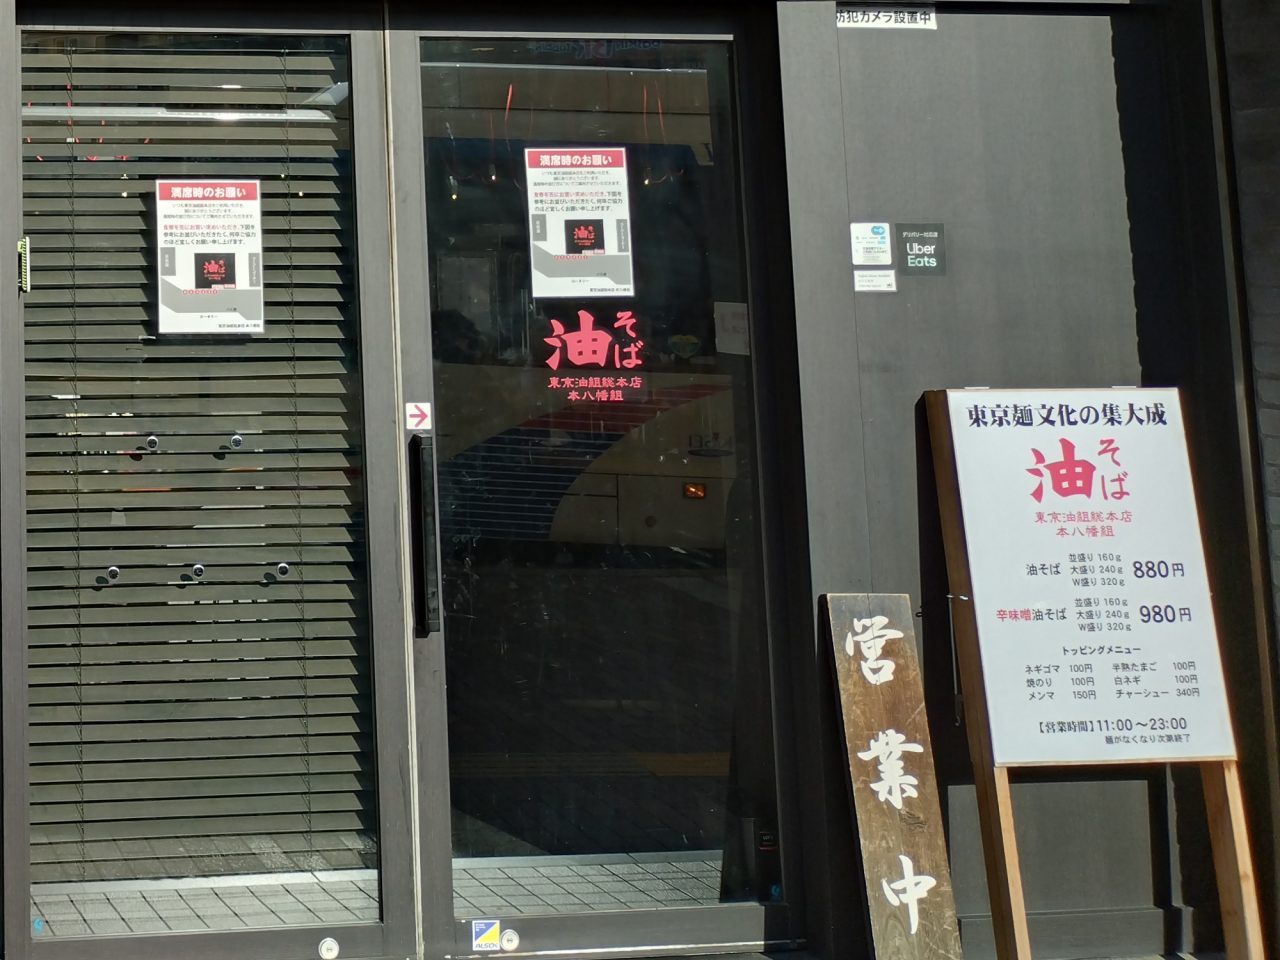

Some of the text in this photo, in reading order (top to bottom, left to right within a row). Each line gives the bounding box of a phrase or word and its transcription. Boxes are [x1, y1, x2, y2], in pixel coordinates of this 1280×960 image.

[540, 155, 612, 166] 満席時のお願い
[170, 187, 246, 198] 満席時のお願い
[906, 243, 935, 254] Uber
[907, 256, 937, 267] Eats
[543, 309, 644, 370] 油 そば
[547, 376, 642, 389] 東京油組総本店
[567, 390, 624, 402] 本八幡組
[966, 403, 1168, 428] 東京麺文化の集大成
[1025, 437, 1130, 504] 油 そば
[1034, 510, 1133, 523] 東京油組総本店
[1055, 525, 1116, 537] 本八幡組
[1025, 563, 1061, 576] 油そば
[1062, 646, 1141, 655] トッピングメニュー
[1024, 664, 1093, 674] ネギゴマ 100円
[1112, 661, 1196, 672] 半熟たまご 100円
[1026, 677, 1095, 688] 焼のり 100円
[1114, 674, 1198, 685] 白ネギ 100円
[1028, 690, 1097, 701] メンマ 150円
[1115, 688, 1200, 699] チャーシュー 340円
[846, 615, 937, 935] 営業中
